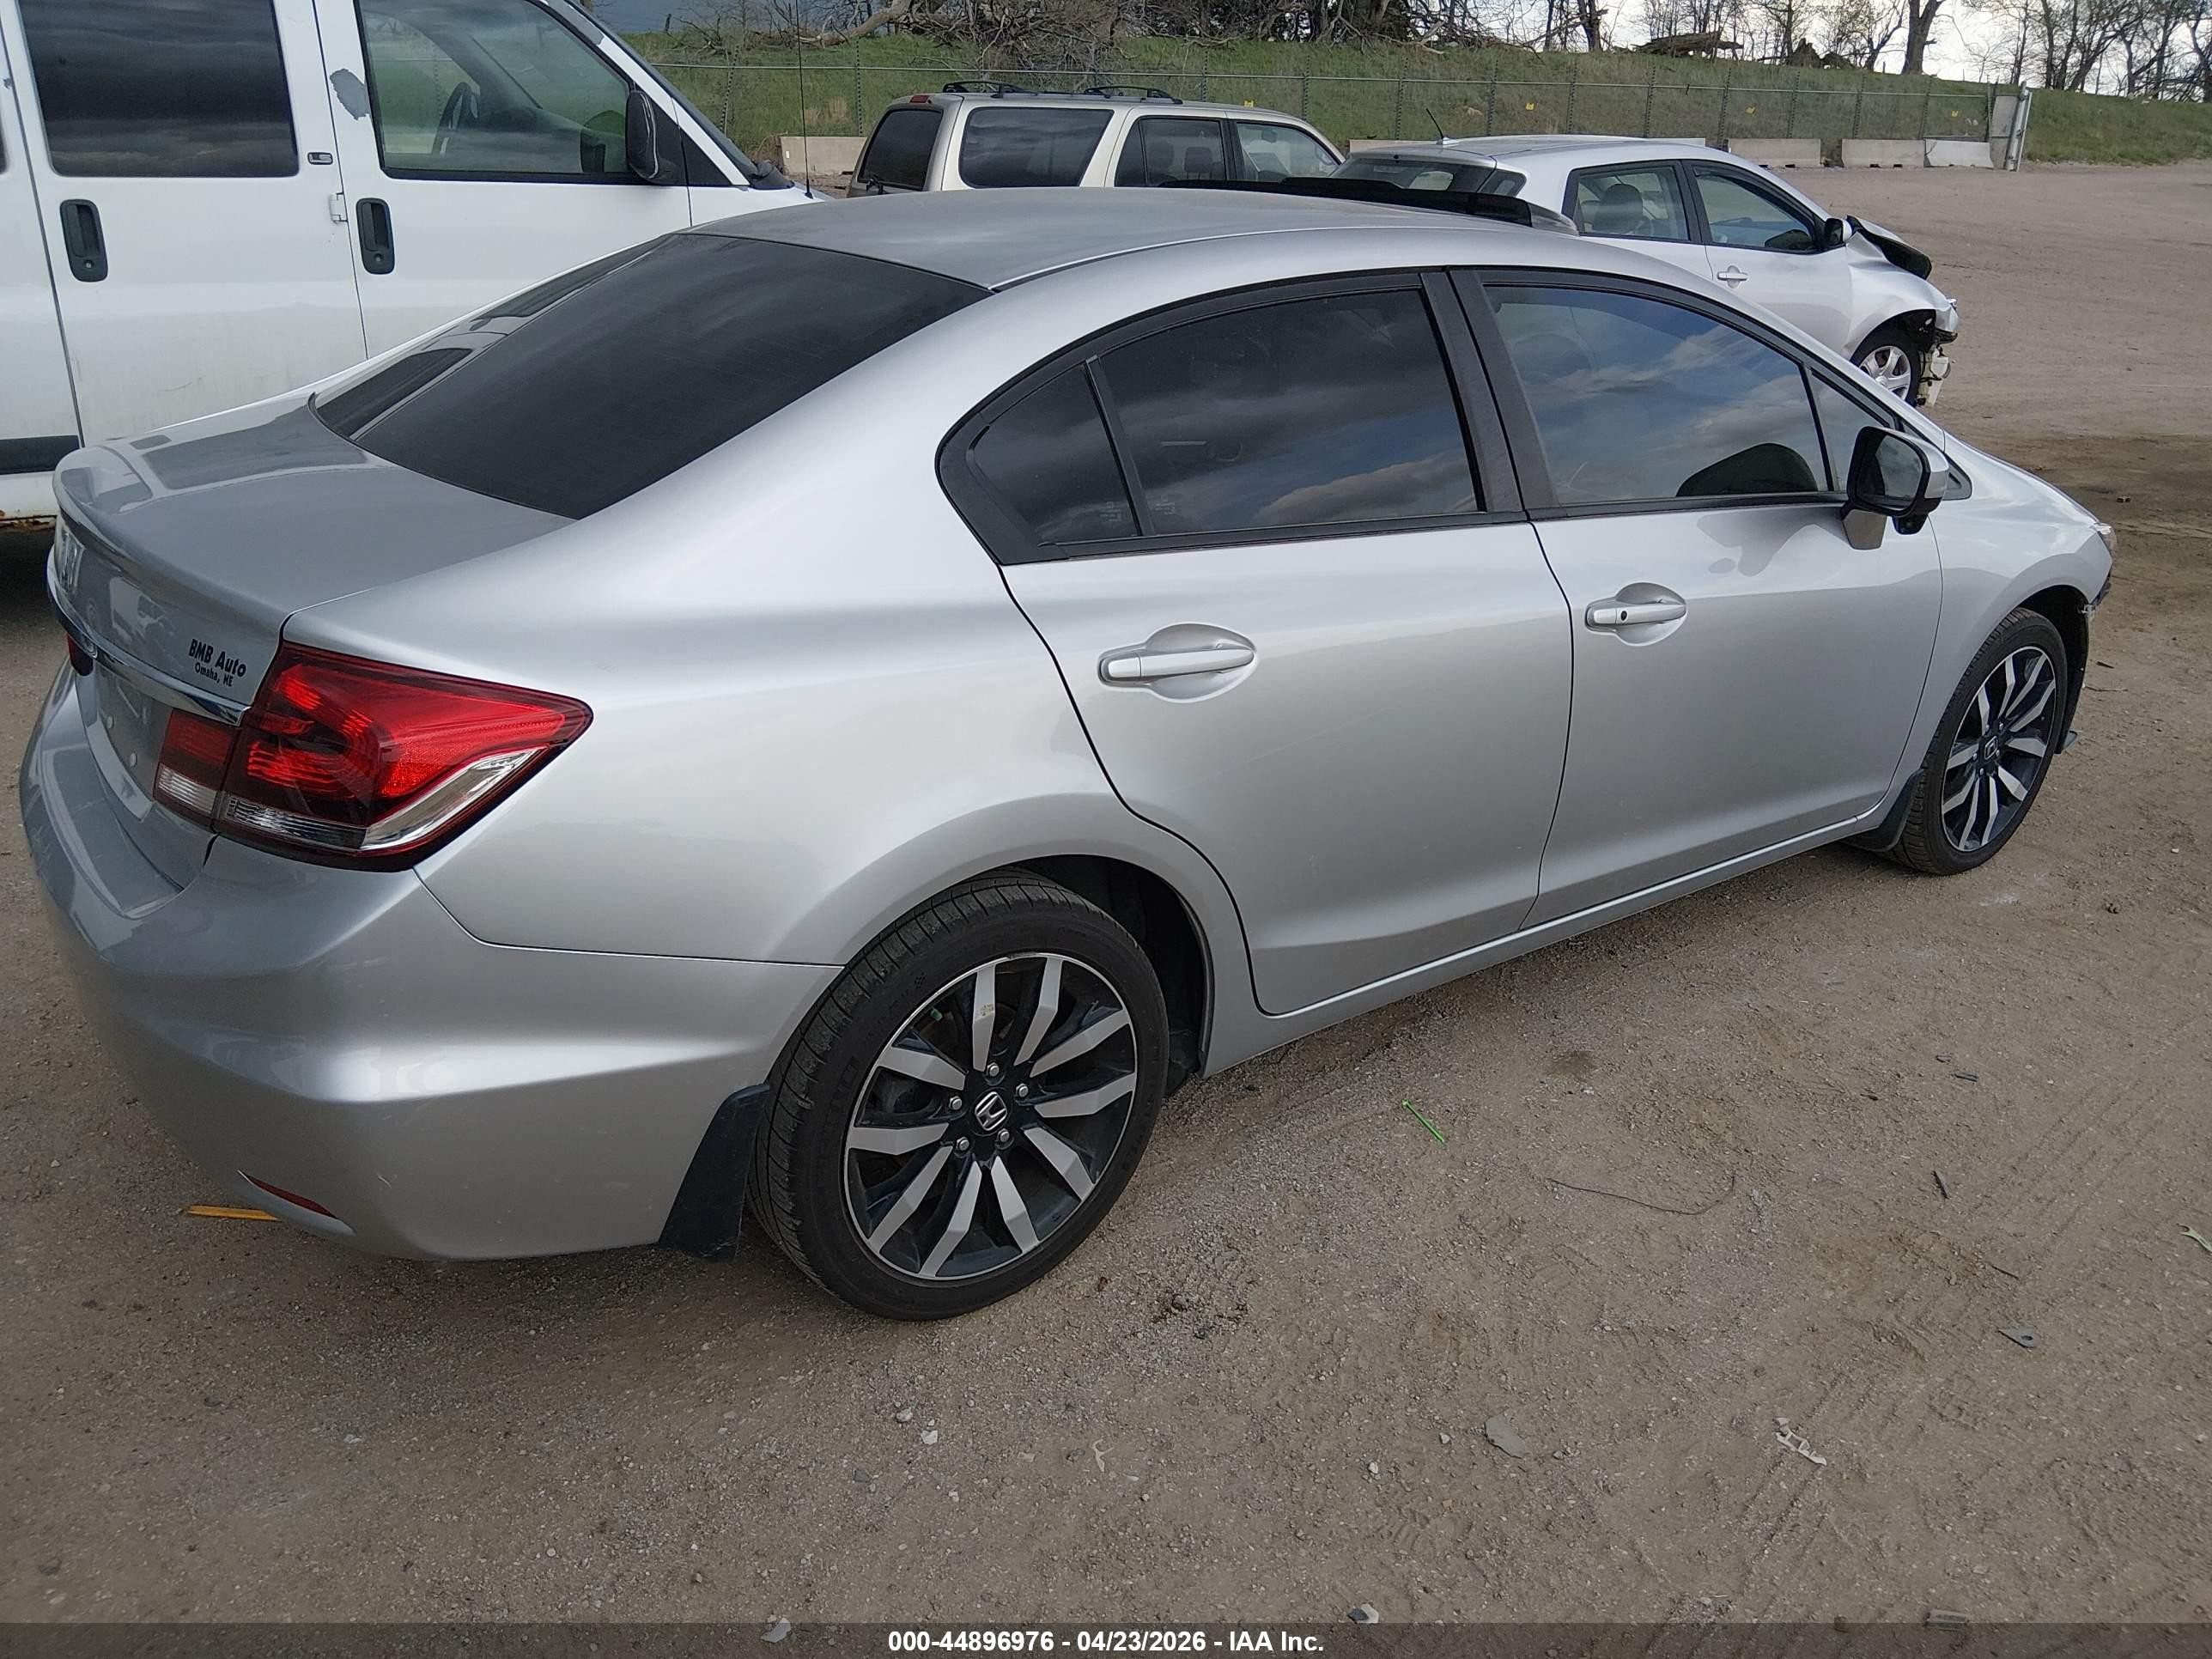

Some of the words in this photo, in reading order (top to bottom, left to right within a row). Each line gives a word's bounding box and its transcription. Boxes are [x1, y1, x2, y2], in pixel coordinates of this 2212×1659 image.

[189, 638, 214, 664] BMB
[215, 651, 246, 678] Auto
[194, 662, 221, 684] Omaha,
[223, 673, 234, 687] NE
